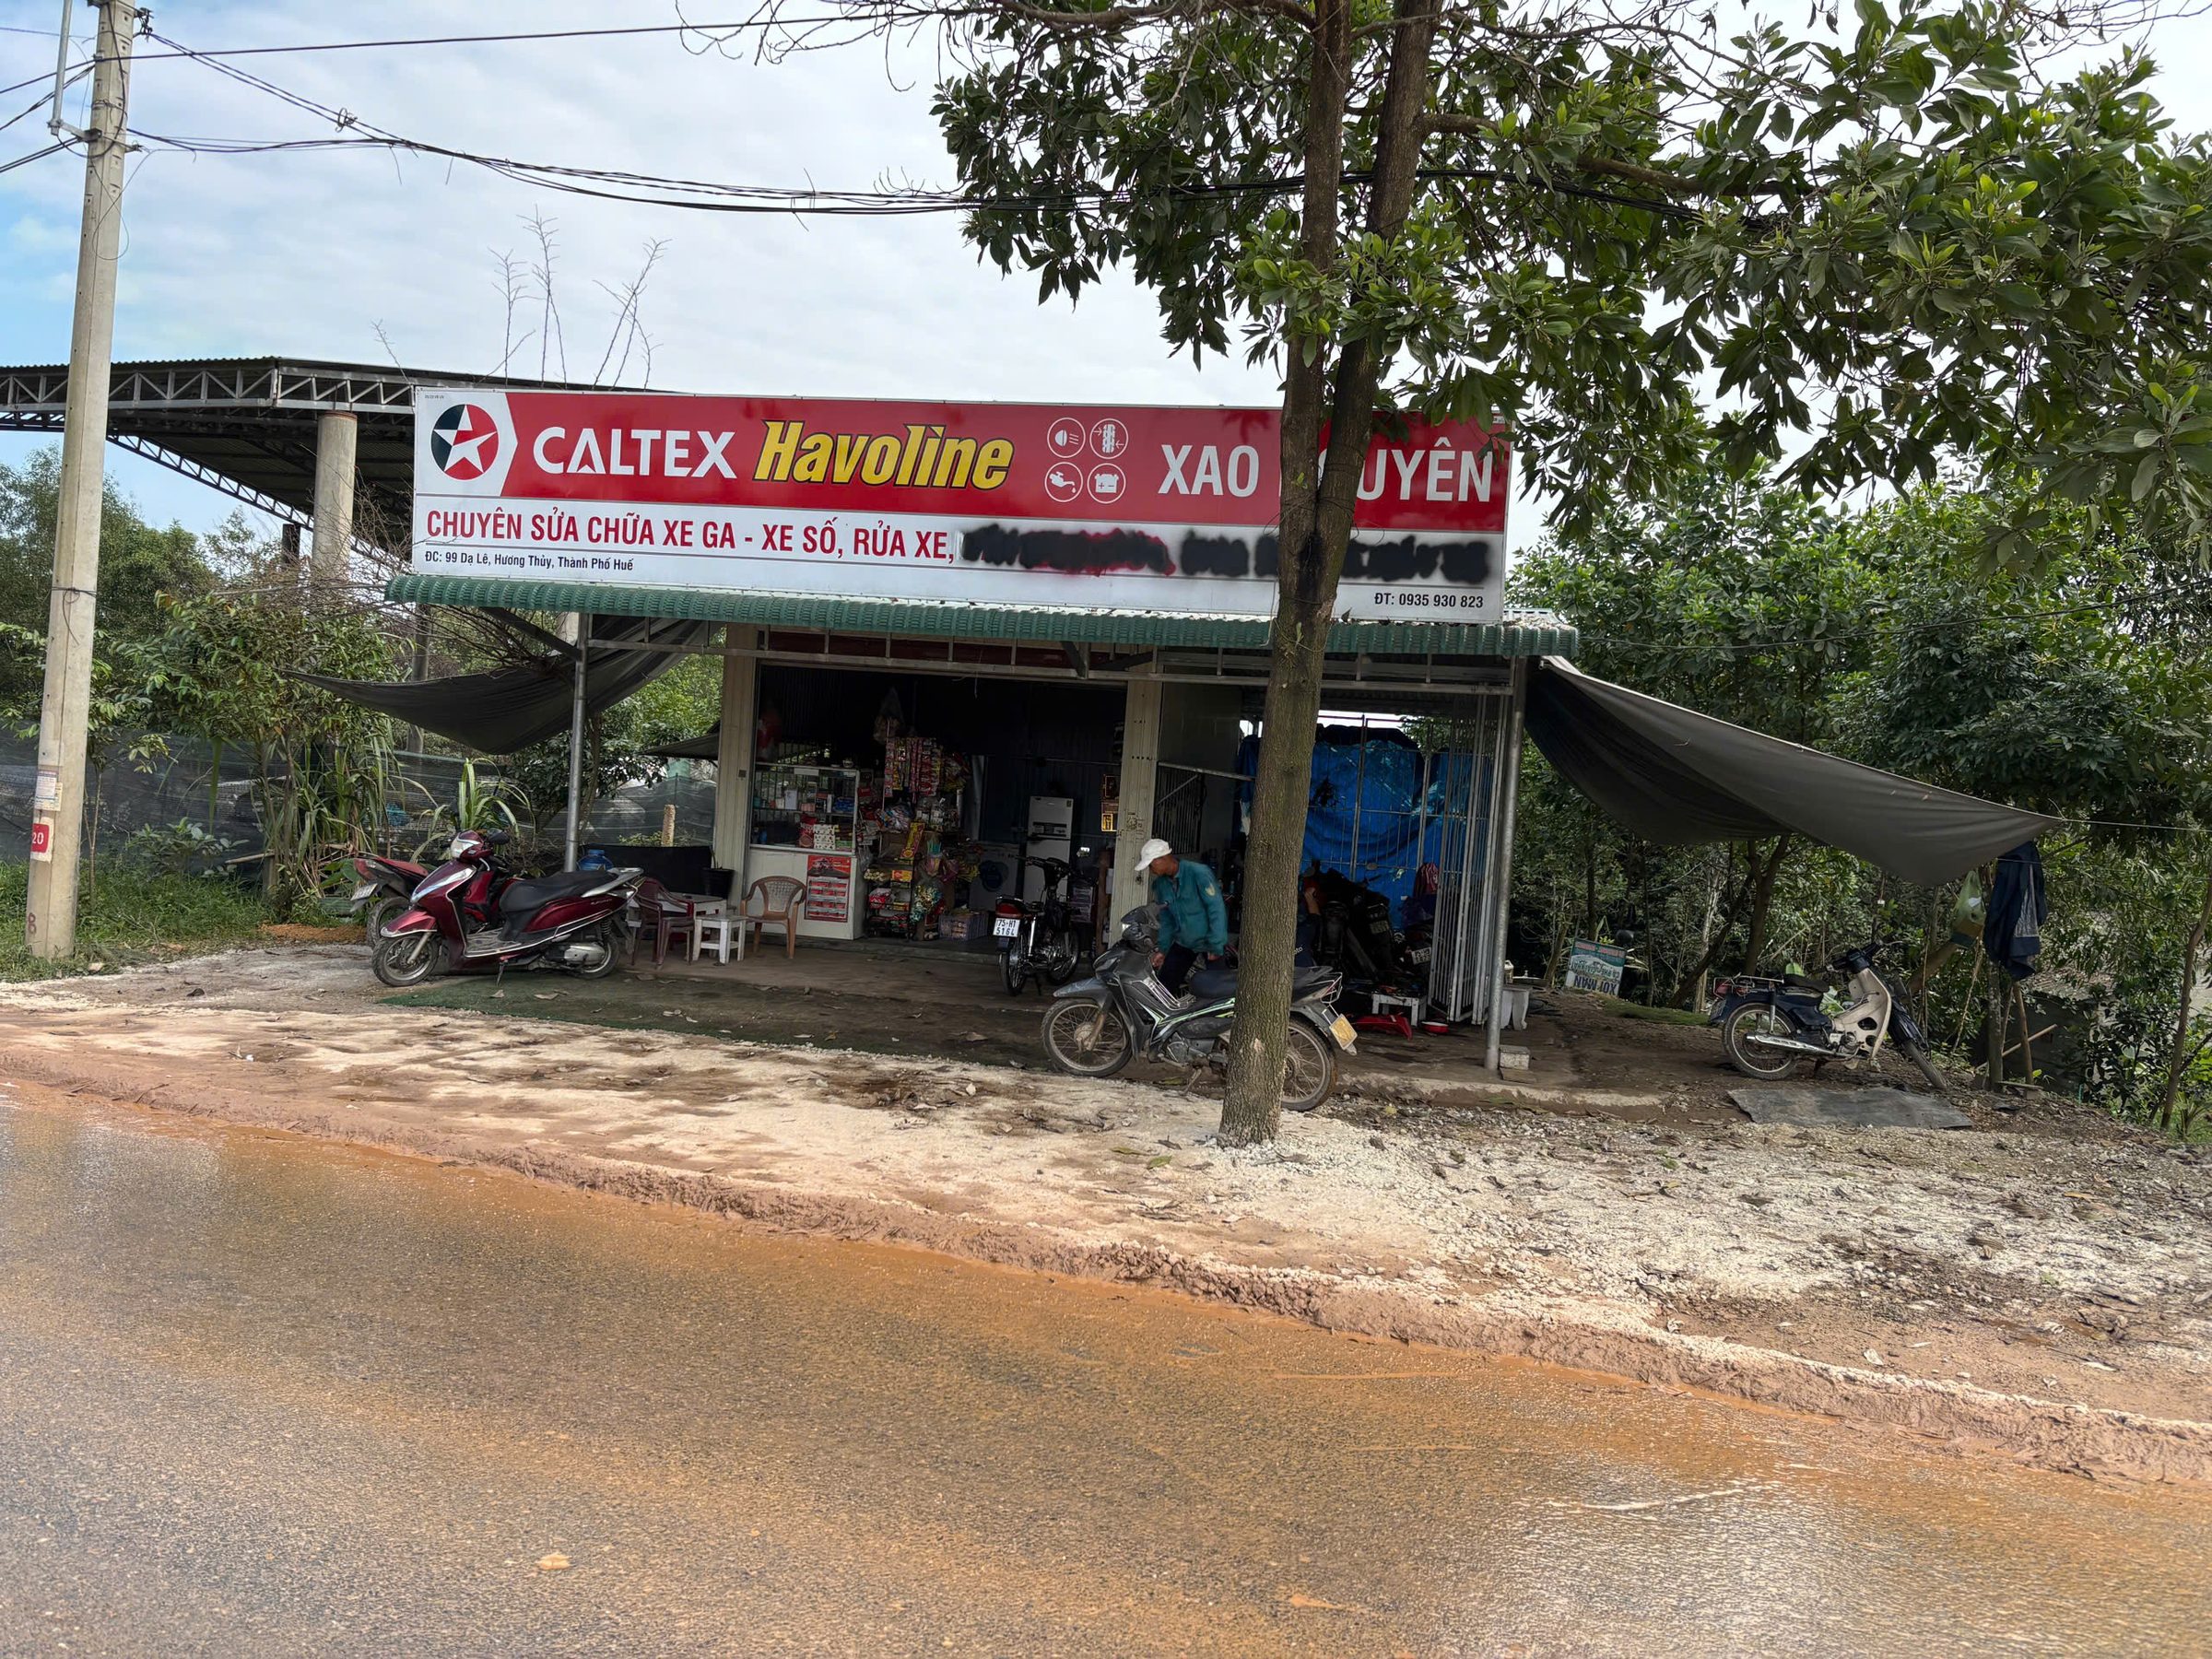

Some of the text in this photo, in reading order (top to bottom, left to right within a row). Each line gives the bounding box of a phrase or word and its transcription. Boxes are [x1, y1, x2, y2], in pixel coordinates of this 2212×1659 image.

[533, 427, 737, 479] CALTEX
[1159, 437, 1493, 502] XAO UYÊN
[425, 551, 634, 571] ĐC: 99 Dạ Lê, Hương Thủy, Thành Phố Huế
[427, 507, 523, 540] CHUYÊN
[531, 507, 579, 542] SỬA
[588, 512, 655, 545] CHỮA
[663, 520, 693, 547] XE
[702, 521, 735, 549] GA
[761, 524, 794, 551] XE
[803, 517, 843, 559] SỐ,
[853, 520, 906, 557] RỬA
[914, 531, 955, 563] XE,
[1374, 593, 1484, 608] ĐT: 0935 930 823
